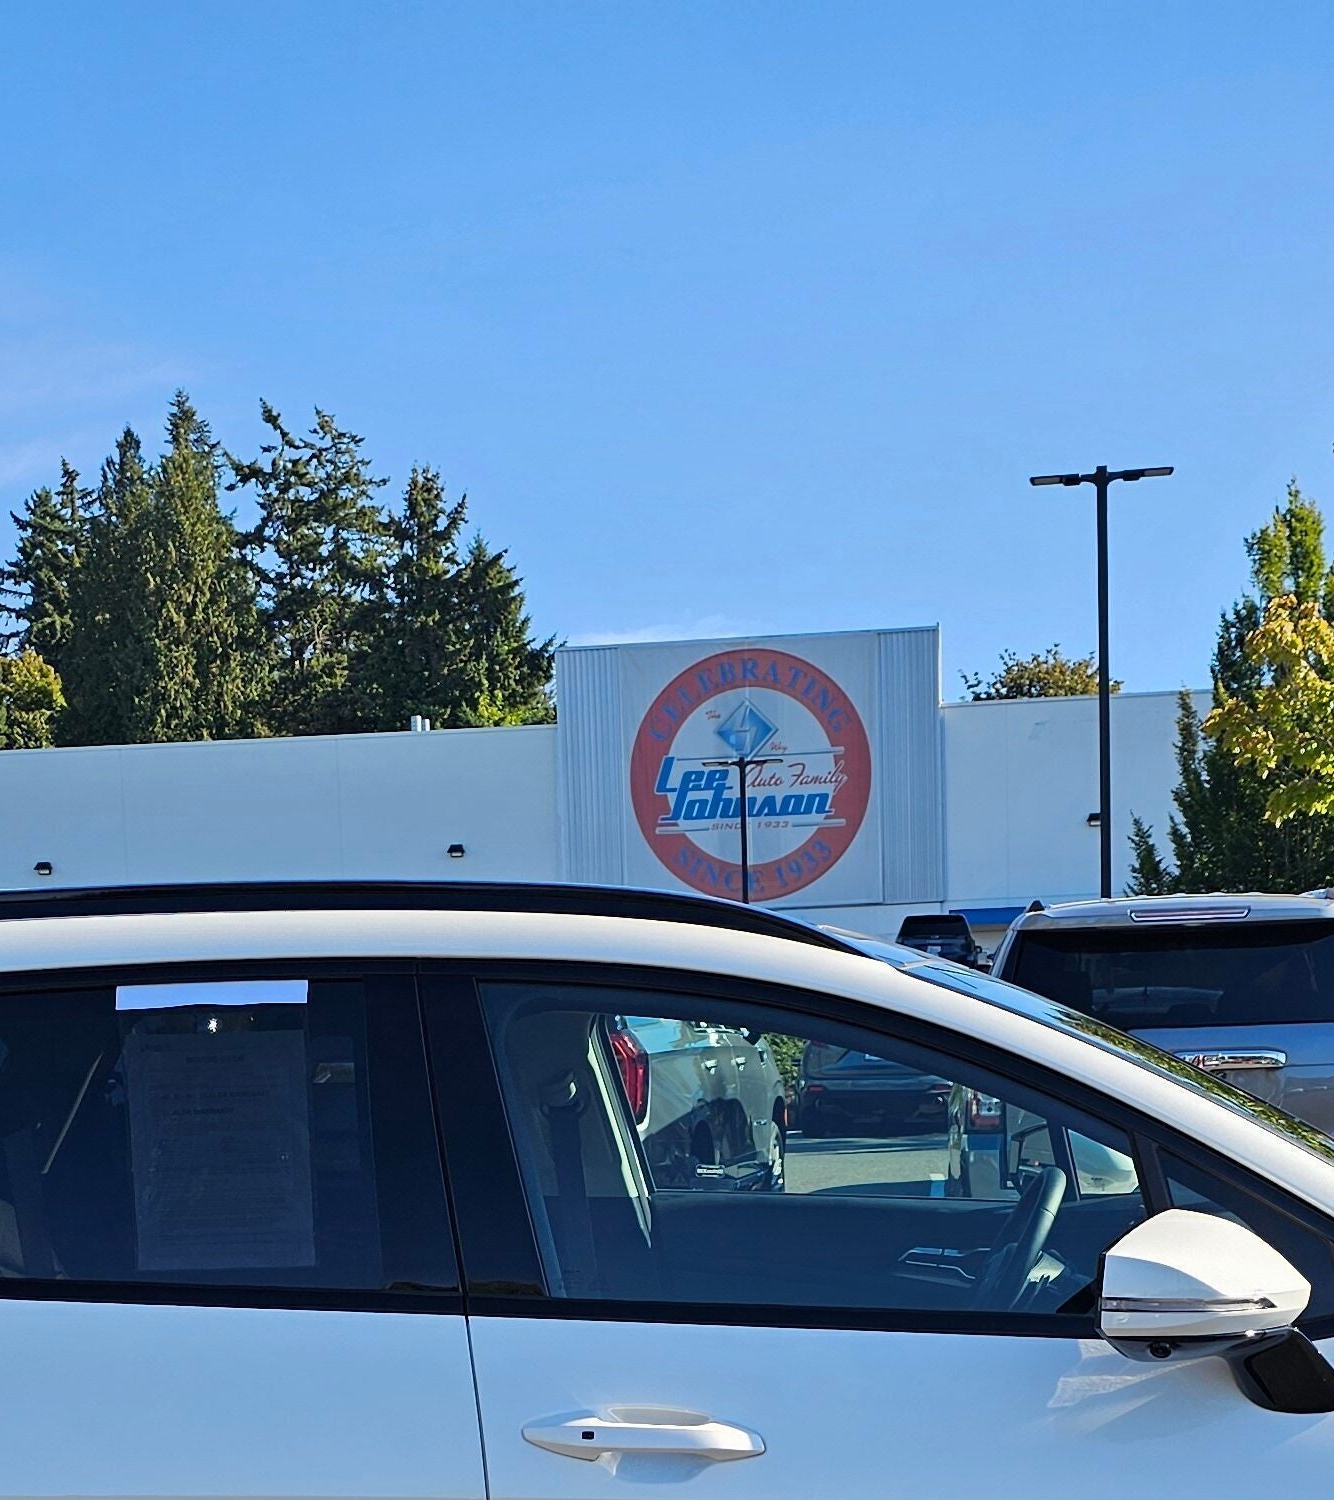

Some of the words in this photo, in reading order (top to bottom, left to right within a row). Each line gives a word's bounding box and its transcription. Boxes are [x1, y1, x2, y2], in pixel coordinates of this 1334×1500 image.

[650, 658, 851, 742] CELEBRATING
[655, 756, 734, 793] Lee
[786, 760, 846, 795] Family
[661, 783, 835, 821] Johnson
[757, 820, 790, 829] 1933
[673, 847, 764, 893] SINCE
[774, 840, 833, 889] 1933
